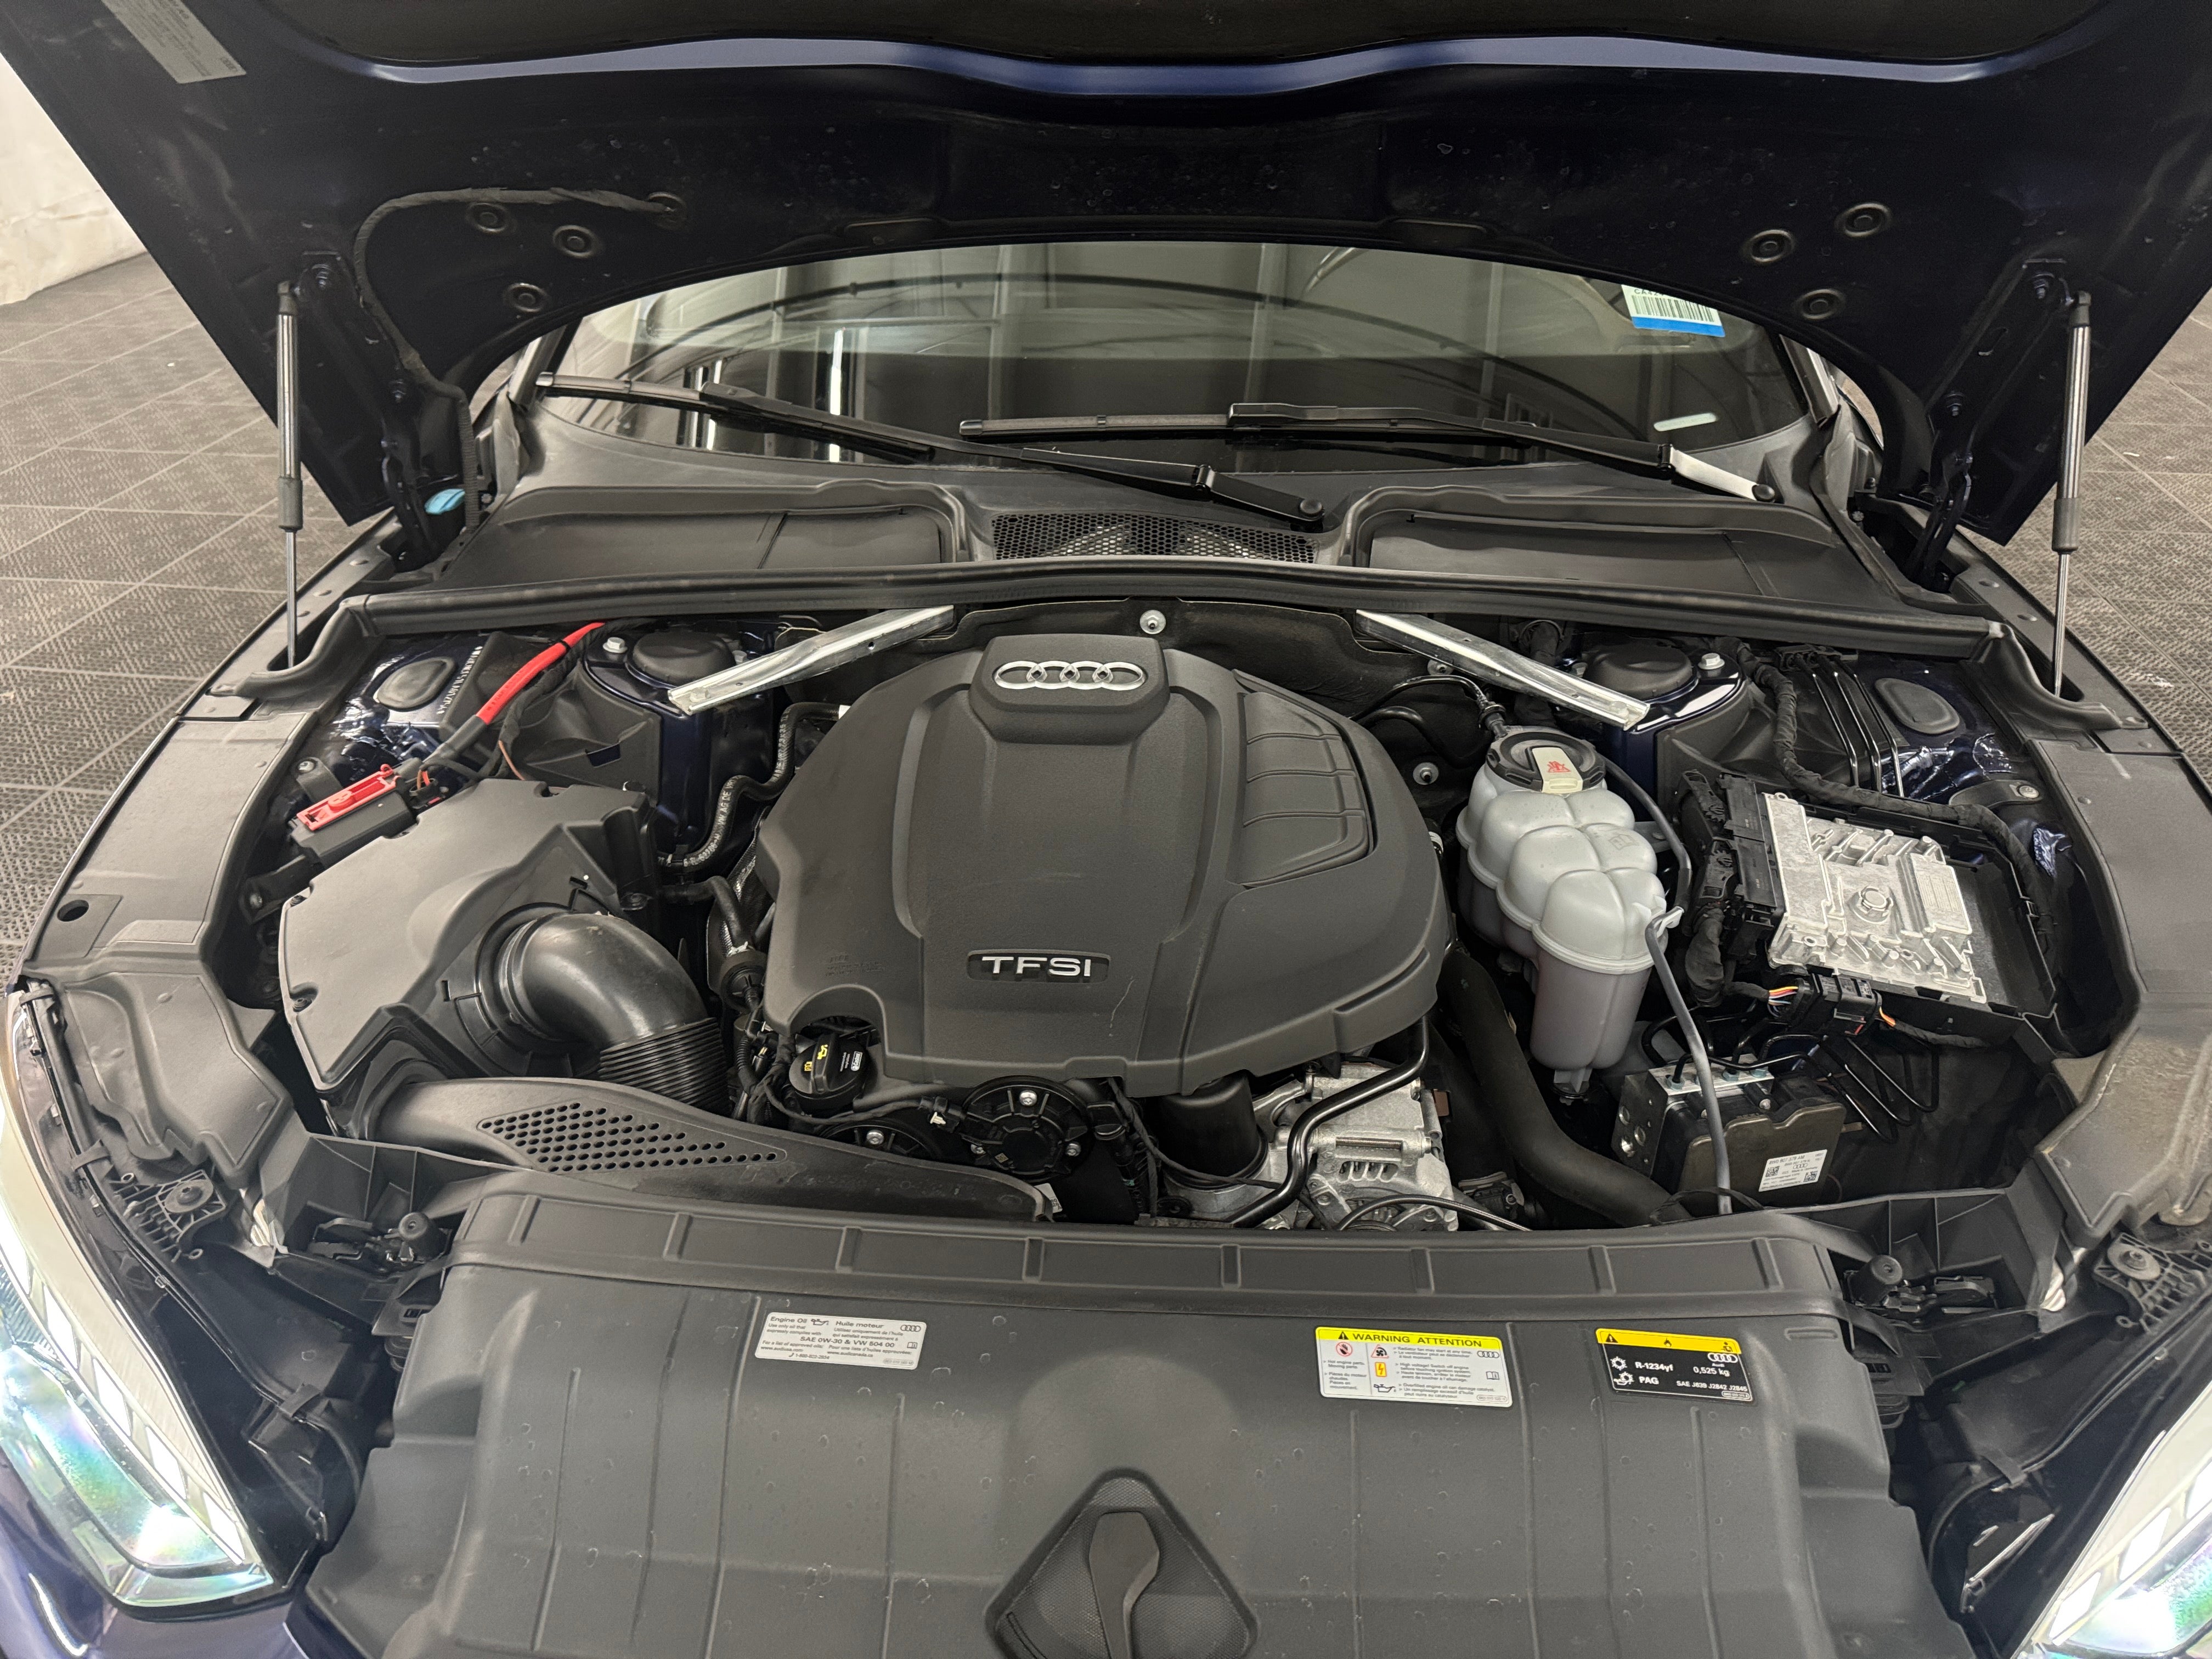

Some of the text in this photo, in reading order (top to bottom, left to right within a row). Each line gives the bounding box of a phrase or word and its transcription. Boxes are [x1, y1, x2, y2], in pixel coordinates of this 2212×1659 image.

[982, 957, 1091, 977] TFSI
[1352, 1333, 1482, 1347] WARNING ATTENTION
[1635, 1362, 1673, 1372] R-1234yf
[1718, 1368, 1730, 1376] kg
